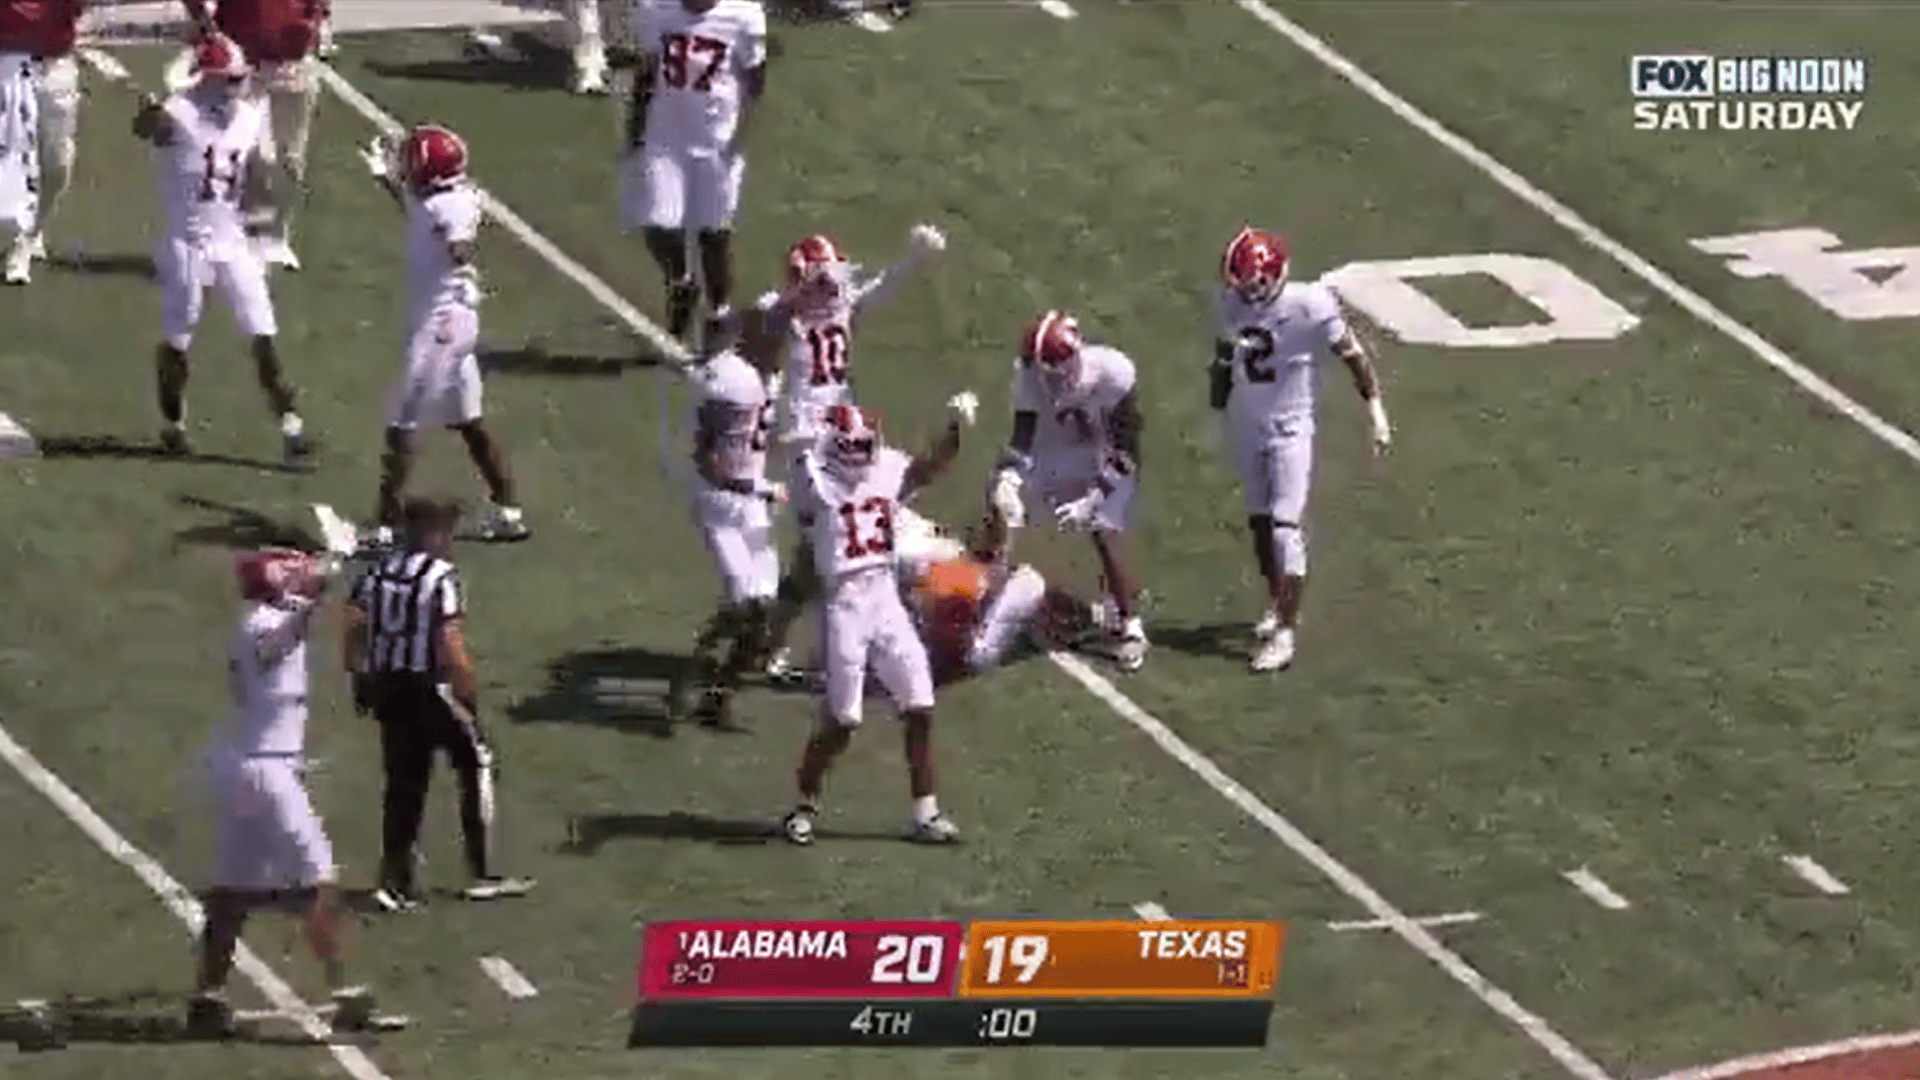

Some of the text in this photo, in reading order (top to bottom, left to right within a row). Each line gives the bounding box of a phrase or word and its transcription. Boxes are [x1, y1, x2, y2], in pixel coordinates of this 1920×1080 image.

[809, 325, 849, 386] 10
[1240, 327, 1276, 383] 2
[839, 497, 893, 559] 13
